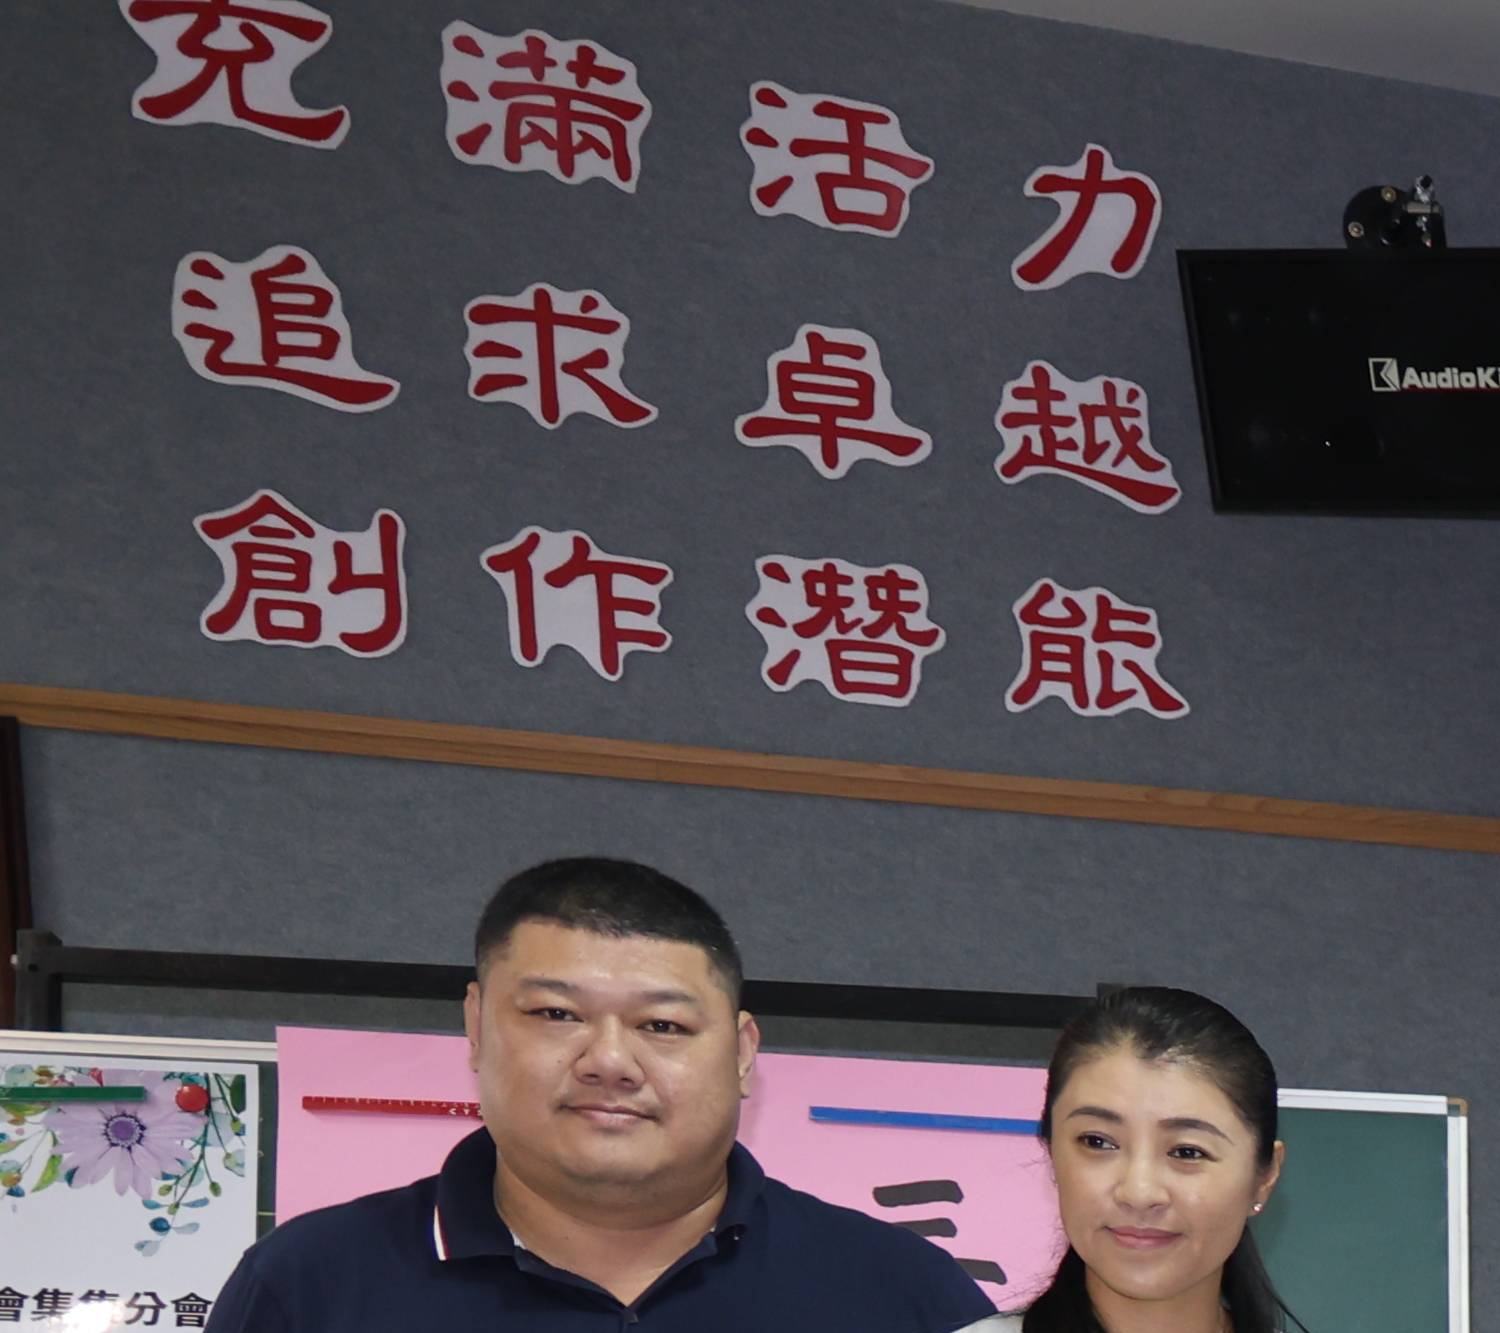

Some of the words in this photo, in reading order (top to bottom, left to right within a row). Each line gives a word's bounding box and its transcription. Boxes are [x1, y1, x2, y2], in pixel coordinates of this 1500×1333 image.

[132, 0, 1157, 285] 充滿活力
[182, 255, 1178, 507] 追求卓越
[199, 494, 1184, 712] 創作潛能
